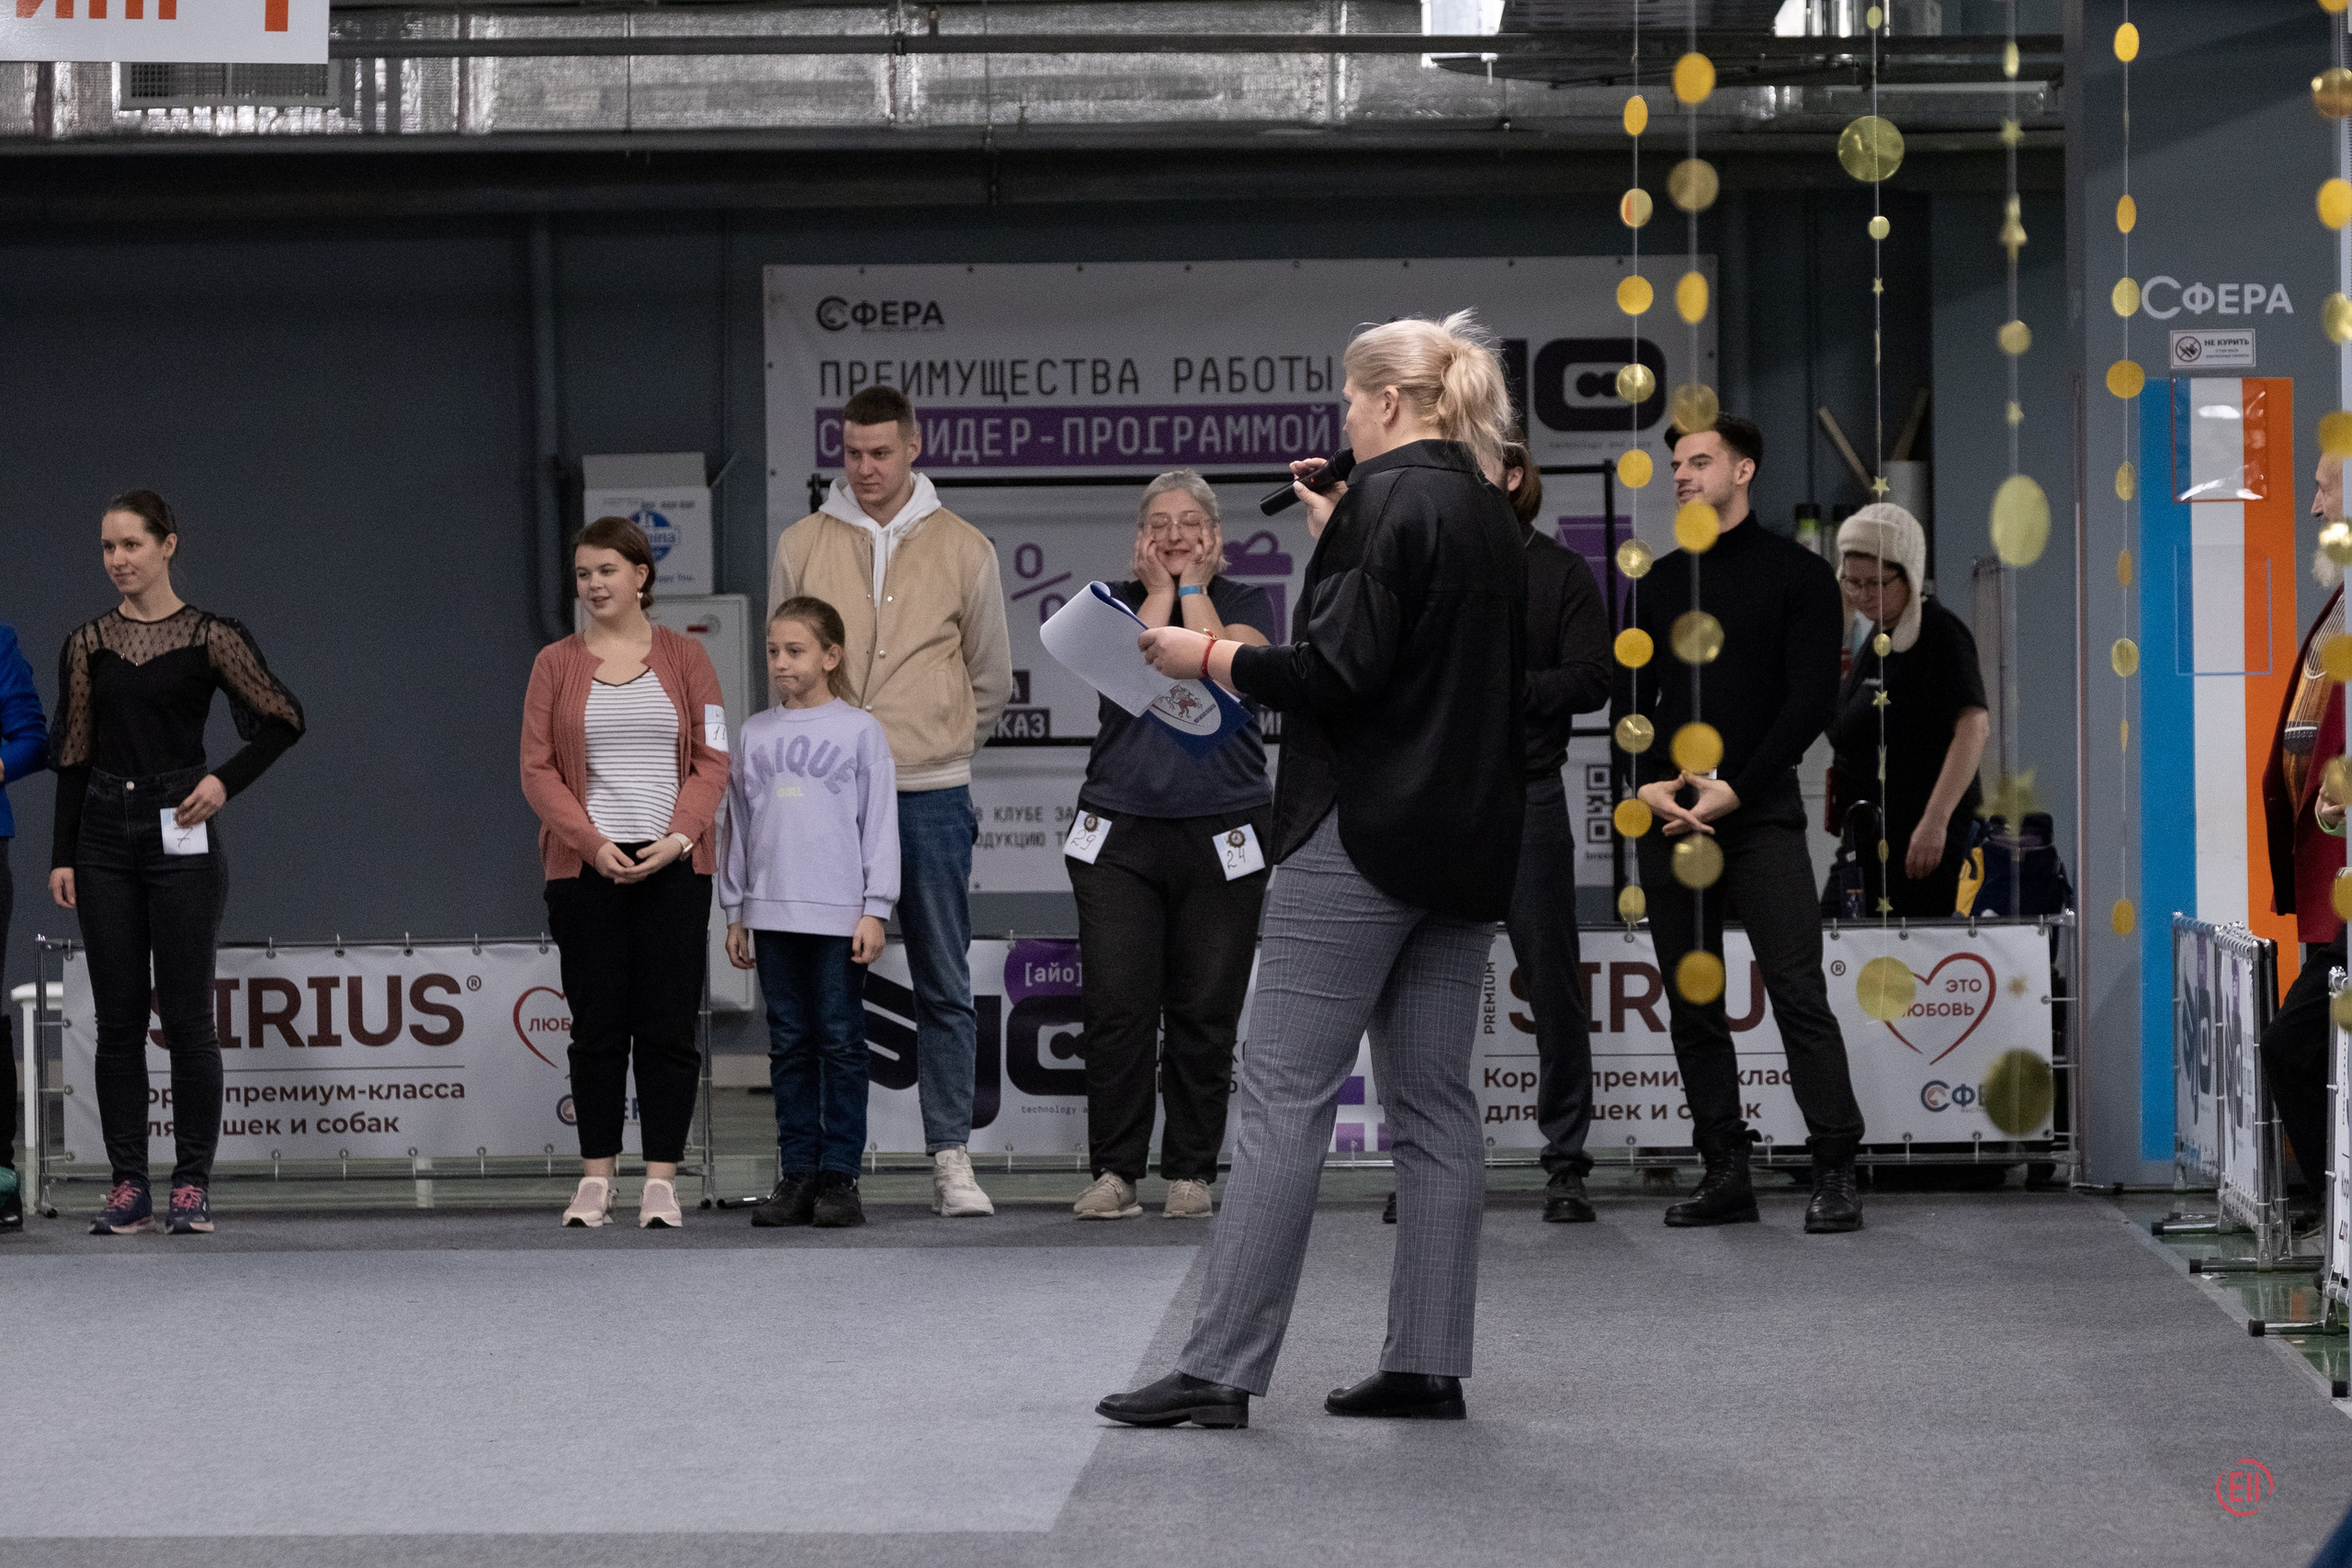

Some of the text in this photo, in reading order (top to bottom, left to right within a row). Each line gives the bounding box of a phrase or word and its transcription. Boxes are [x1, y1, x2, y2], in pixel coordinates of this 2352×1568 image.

[2141, 276, 2294, 320] СФЕРА
[816, 295, 945, 331] СФЕРА
[2217, 338, 2250, 346] КУРИТЬ
[820, 355, 1334, 403] ПРЕИМУЩЕСТВА РАБОТЫ
[925, 407, 1330, 465] ИДЕР-ПРОГРАММОЙ
[993, 806, 1044, 823] КЛУБЕ
[1227, 848, 1247, 870] 24
[1945, 978, 1983, 993] ЭТО
[1483, 962, 1496, 1035] PREMIUM
[1902, 1002, 1975, 1017] ЮБОВЬ
[1483, 1067, 1538, 1092] Кор
[224, 1080, 466, 1109] премиум-класса
[1021, 1105, 1077, 1115] technology
[1485, 1103, 1538, 1125] для
[1651, 1102, 1668, 1120] и
[222, 1118, 280, 1136] шек
[290, 1118, 308, 1135] и
[316, 1110, 401, 1134] собак
